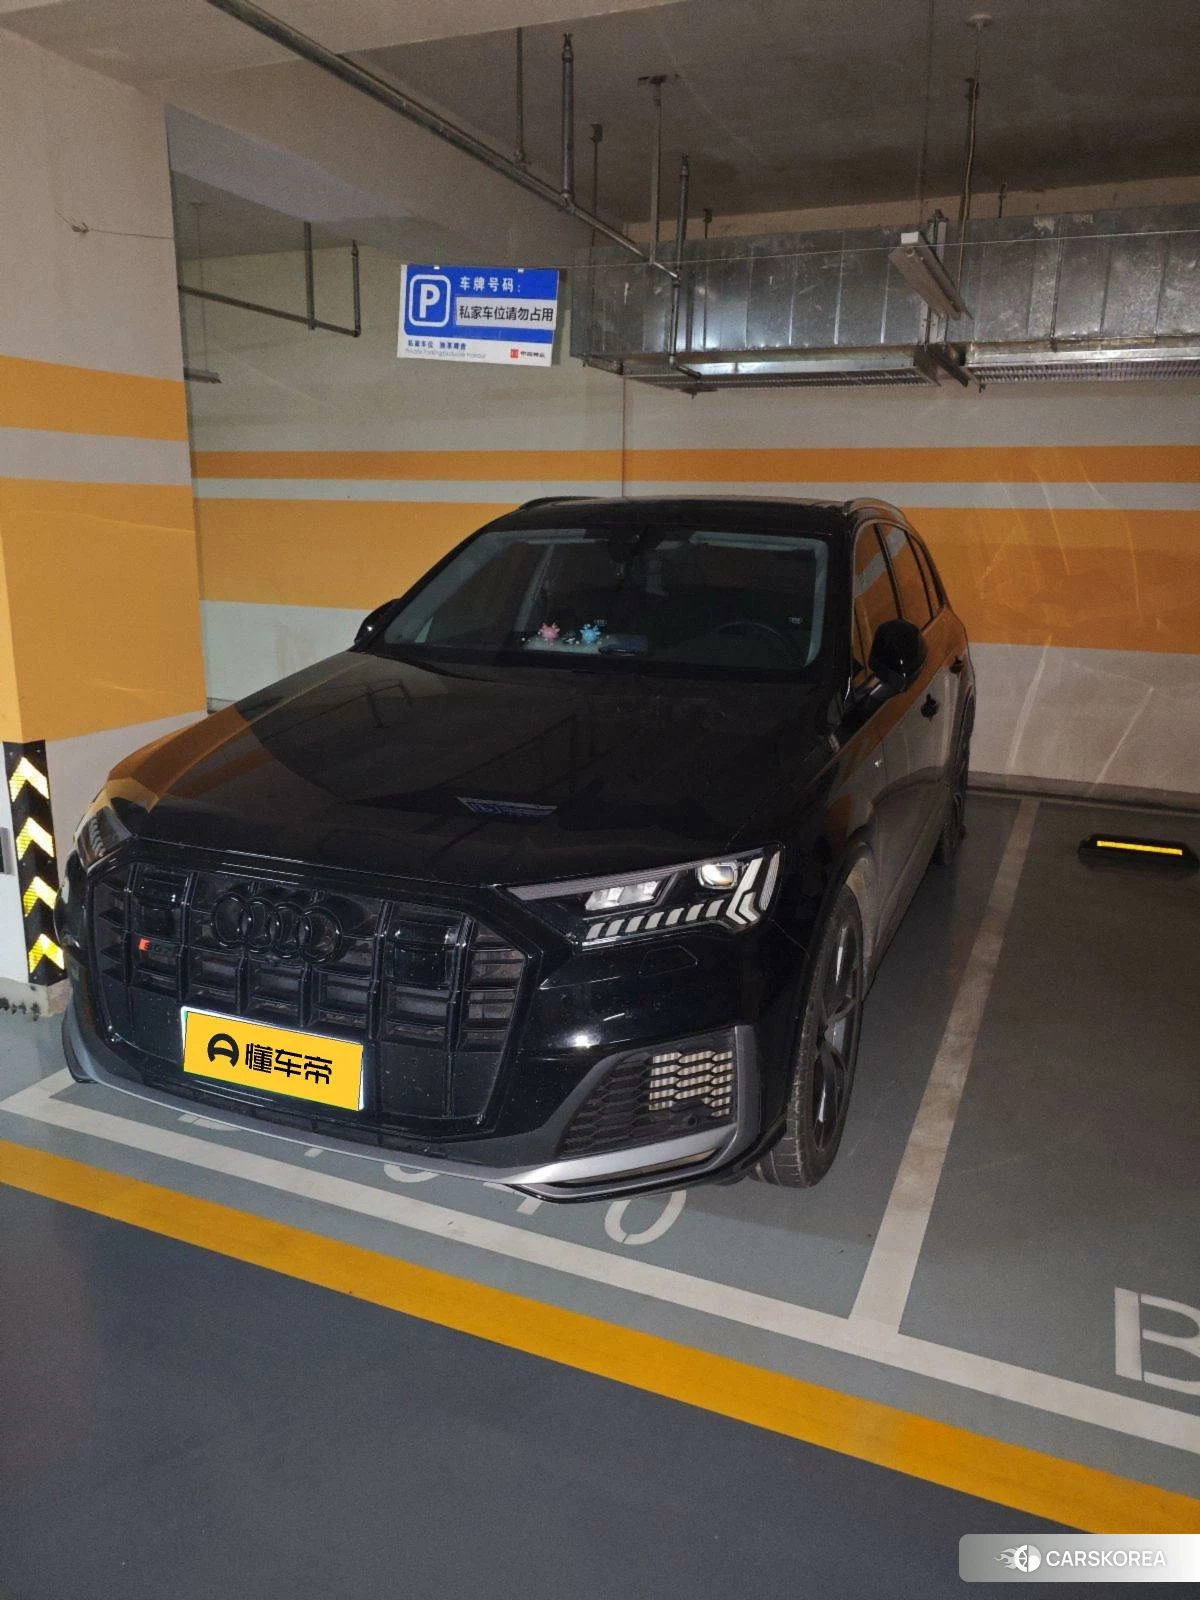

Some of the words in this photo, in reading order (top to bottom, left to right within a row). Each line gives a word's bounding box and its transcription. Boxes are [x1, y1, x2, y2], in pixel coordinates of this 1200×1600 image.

[419, 283, 441, 319] P
[459, 305, 553, 322] 私家车位请勿占用
